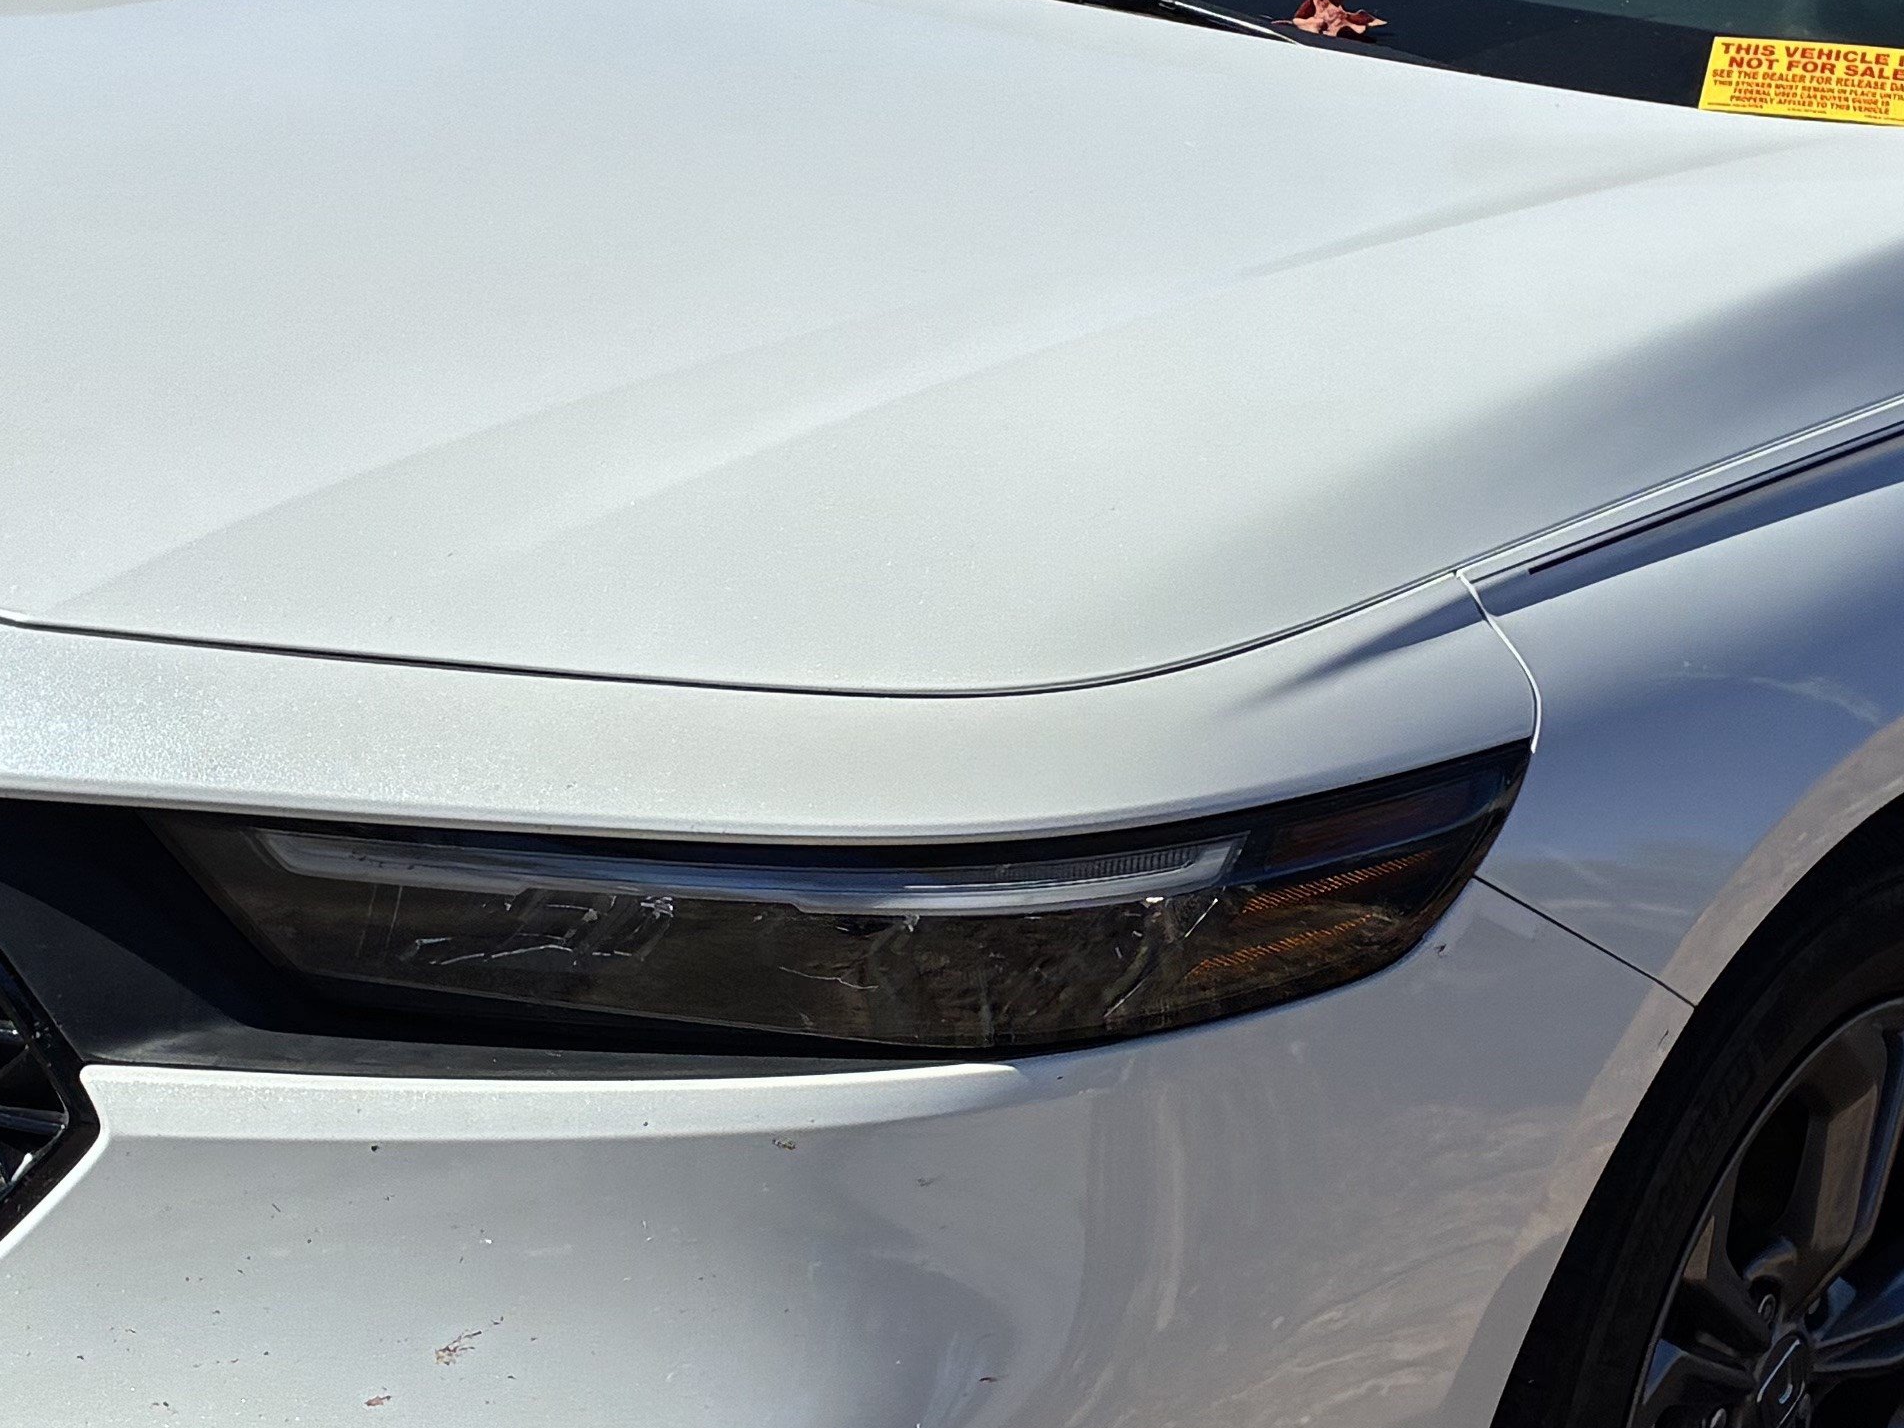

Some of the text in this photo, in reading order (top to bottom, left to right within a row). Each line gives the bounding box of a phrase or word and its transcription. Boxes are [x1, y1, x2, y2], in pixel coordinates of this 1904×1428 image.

[1721, 42, 1776, 57] THIS
[1784, 46, 1890, 66] VEHICLE
[1728, 56, 1780, 70] NOT
[1786, 60, 1837, 75] FOR
[1712, 69, 1734, 78] SEE
[1737, 70, 1759, 80] THE
[1762, 72, 1807, 84] DEALER
[1809, 75, 1833, 86] FOR
[1836, 77, 1887, 91] RELEASE
